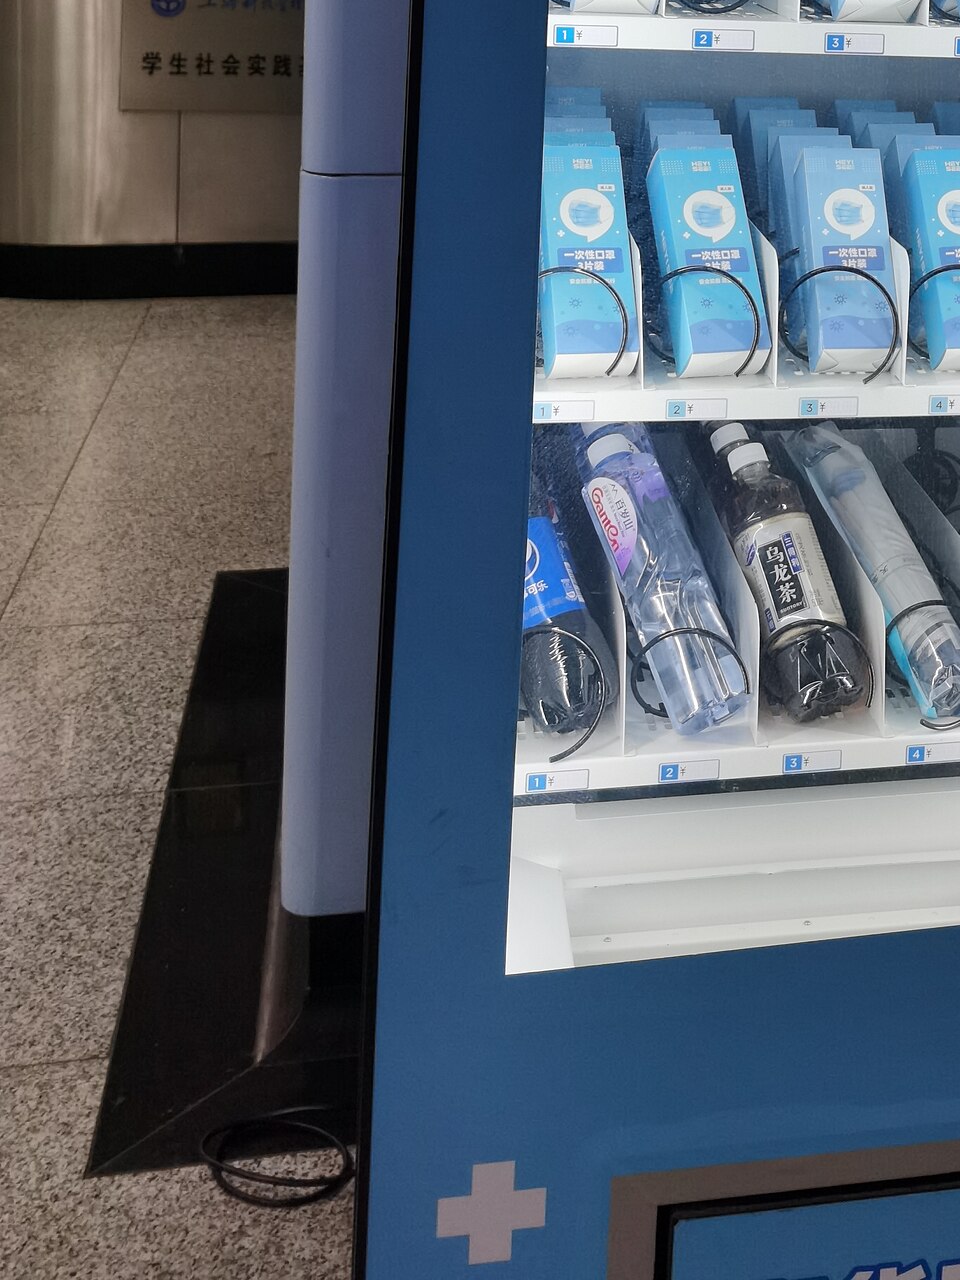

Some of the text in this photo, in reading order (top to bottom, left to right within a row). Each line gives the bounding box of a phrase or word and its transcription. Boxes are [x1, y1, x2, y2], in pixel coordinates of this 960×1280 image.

[562, 30, 567, 40] 1
[700, 34, 707, 44] 2
[832, 38, 839, 48] 3
[142, 51, 303, 77] 学生社会实践
[564, 249, 615, 260] 一次性口罩
[691, 249, 740, 260] 一次性口罩
[829, 248, 878, 258] 一次性口罩
[674, 405, 681, 415] 2
[806, 403, 813, 413] 3
[935, 400, 943, 410] 4
[540, 406, 545, 417] 1
[615, 500, 634, 530] 百岁山
[766, 546, 797, 604] 乌龙茶
[524, 580, 549, 599] 可乐
[780, 602, 803, 614] SUNTORY
[912, 749, 920, 759] 4
[789, 757, 797, 768] 3
[665, 767, 673, 777] 2
[534, 776, 540, 787] 1
